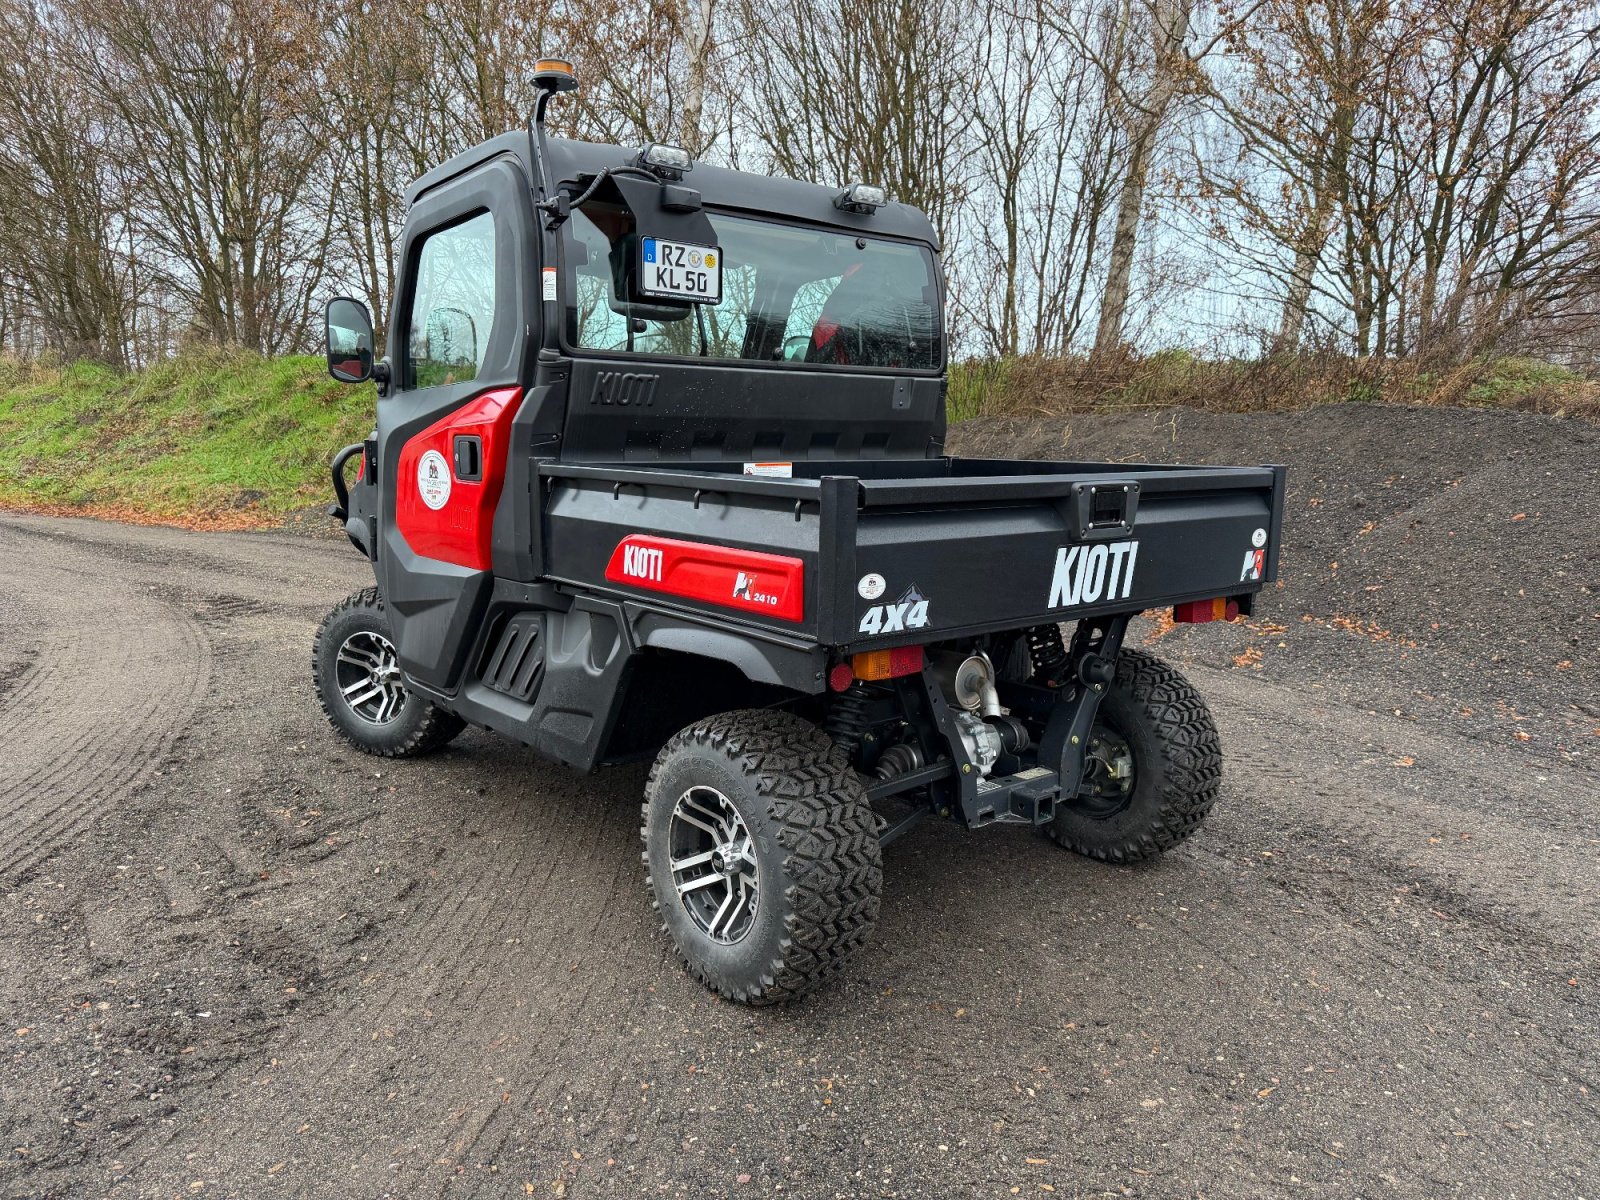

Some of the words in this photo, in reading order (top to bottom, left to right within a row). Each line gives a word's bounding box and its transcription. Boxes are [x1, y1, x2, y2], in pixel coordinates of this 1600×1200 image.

[647, 253, 652, 261] D
[662, 244, 686, 267] RZ
[656, 267, 680, 289] KL
[685, 271, 707, 292] 50
[590, 371, 660, 407] KIOTI
[623, 544, 663, 582] KIOTI
[1047, 541, 1139, 609] KIOTI
[753, 592, 778, 606] 2410
[858, 600, 930, 635] 4X4
